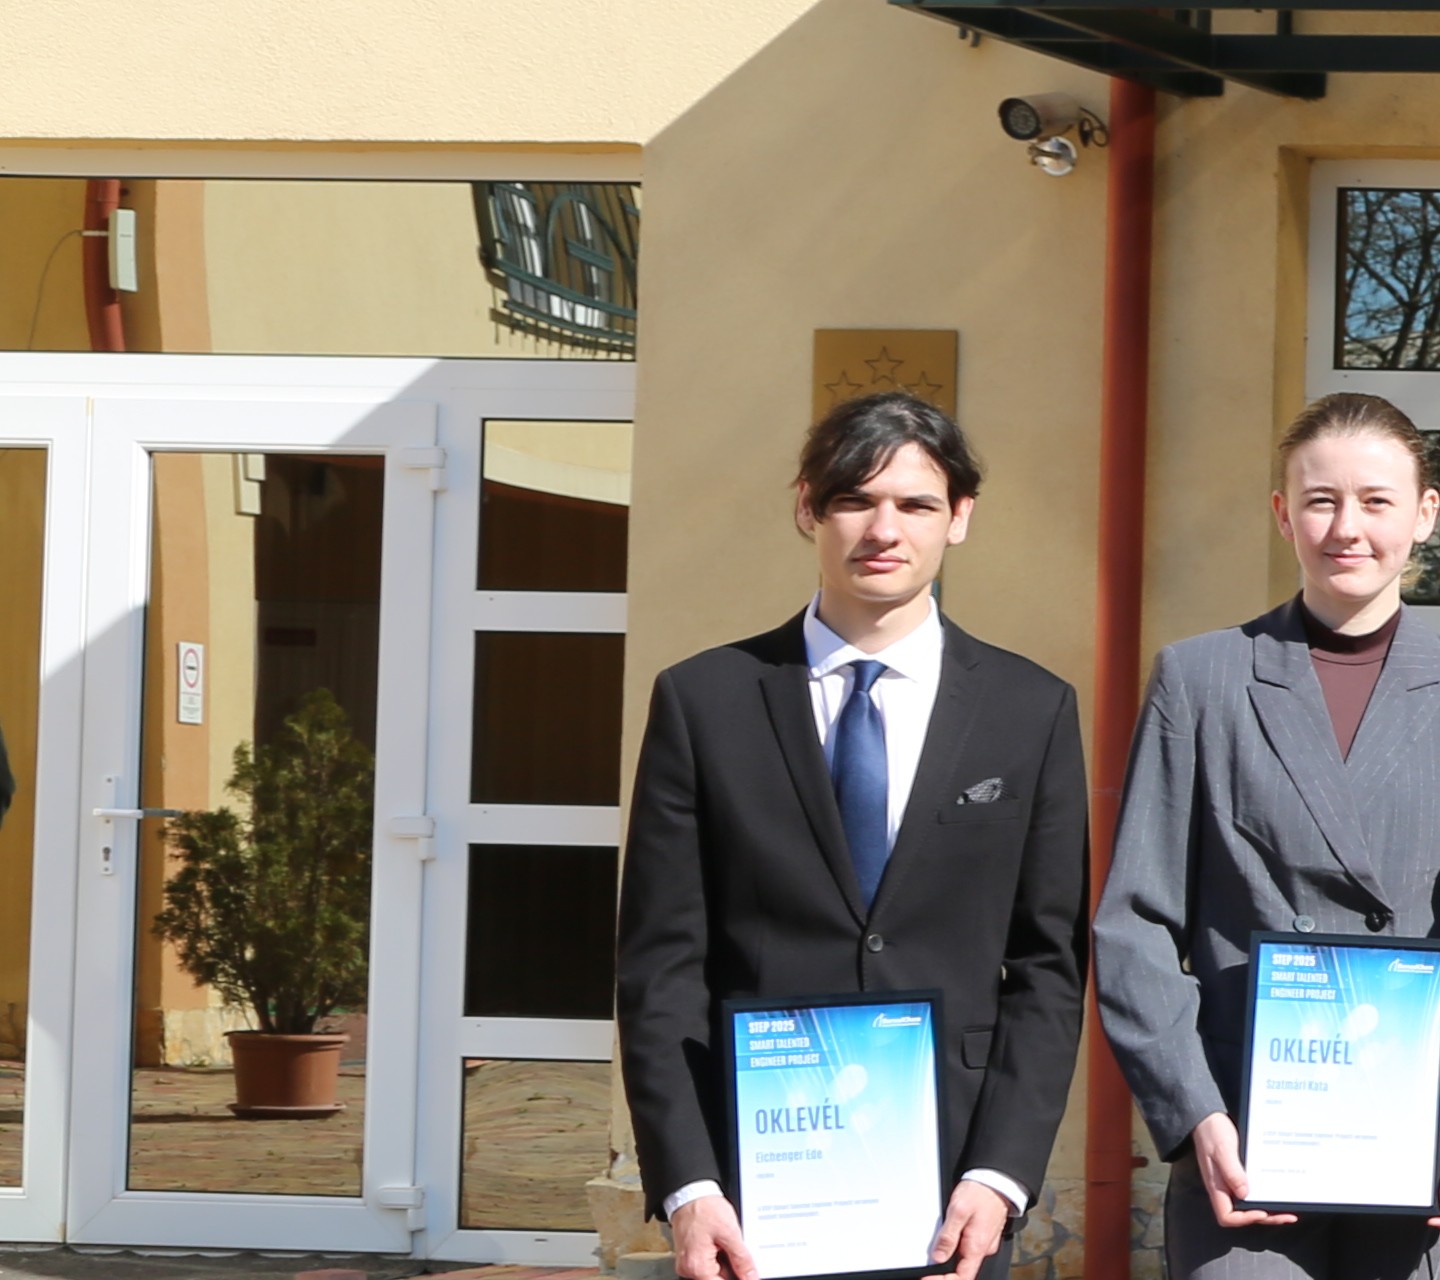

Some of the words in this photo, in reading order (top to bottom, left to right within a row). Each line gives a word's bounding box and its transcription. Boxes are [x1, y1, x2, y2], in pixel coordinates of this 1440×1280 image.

[1272, 953, 1292, 966] STEP
[1293, 954, 1316, 966] 2025
[1271, 971, 1296, 982] SMART
[1296, 972, 1328, 983] TALENTED
[1270, 987, 1305, 998] ENGINEER
[1305, 988, 1336, 1000] PROJECT
[748, 1020, 770, 1033] STEP
[771, 1019, 795, 1033] 2025
[749, 1038, 776, 1050] SMART
[776, 1037, 810, 1048] TALENTED
[1269, 1033, 1353, 1065] OKLEVÉL
[750, 1055, 786, 1067] ENGINEER
[787, 1053, 820, 1065] PROJECT
[755, 1098, 844, 1134] OKLEVÉL
